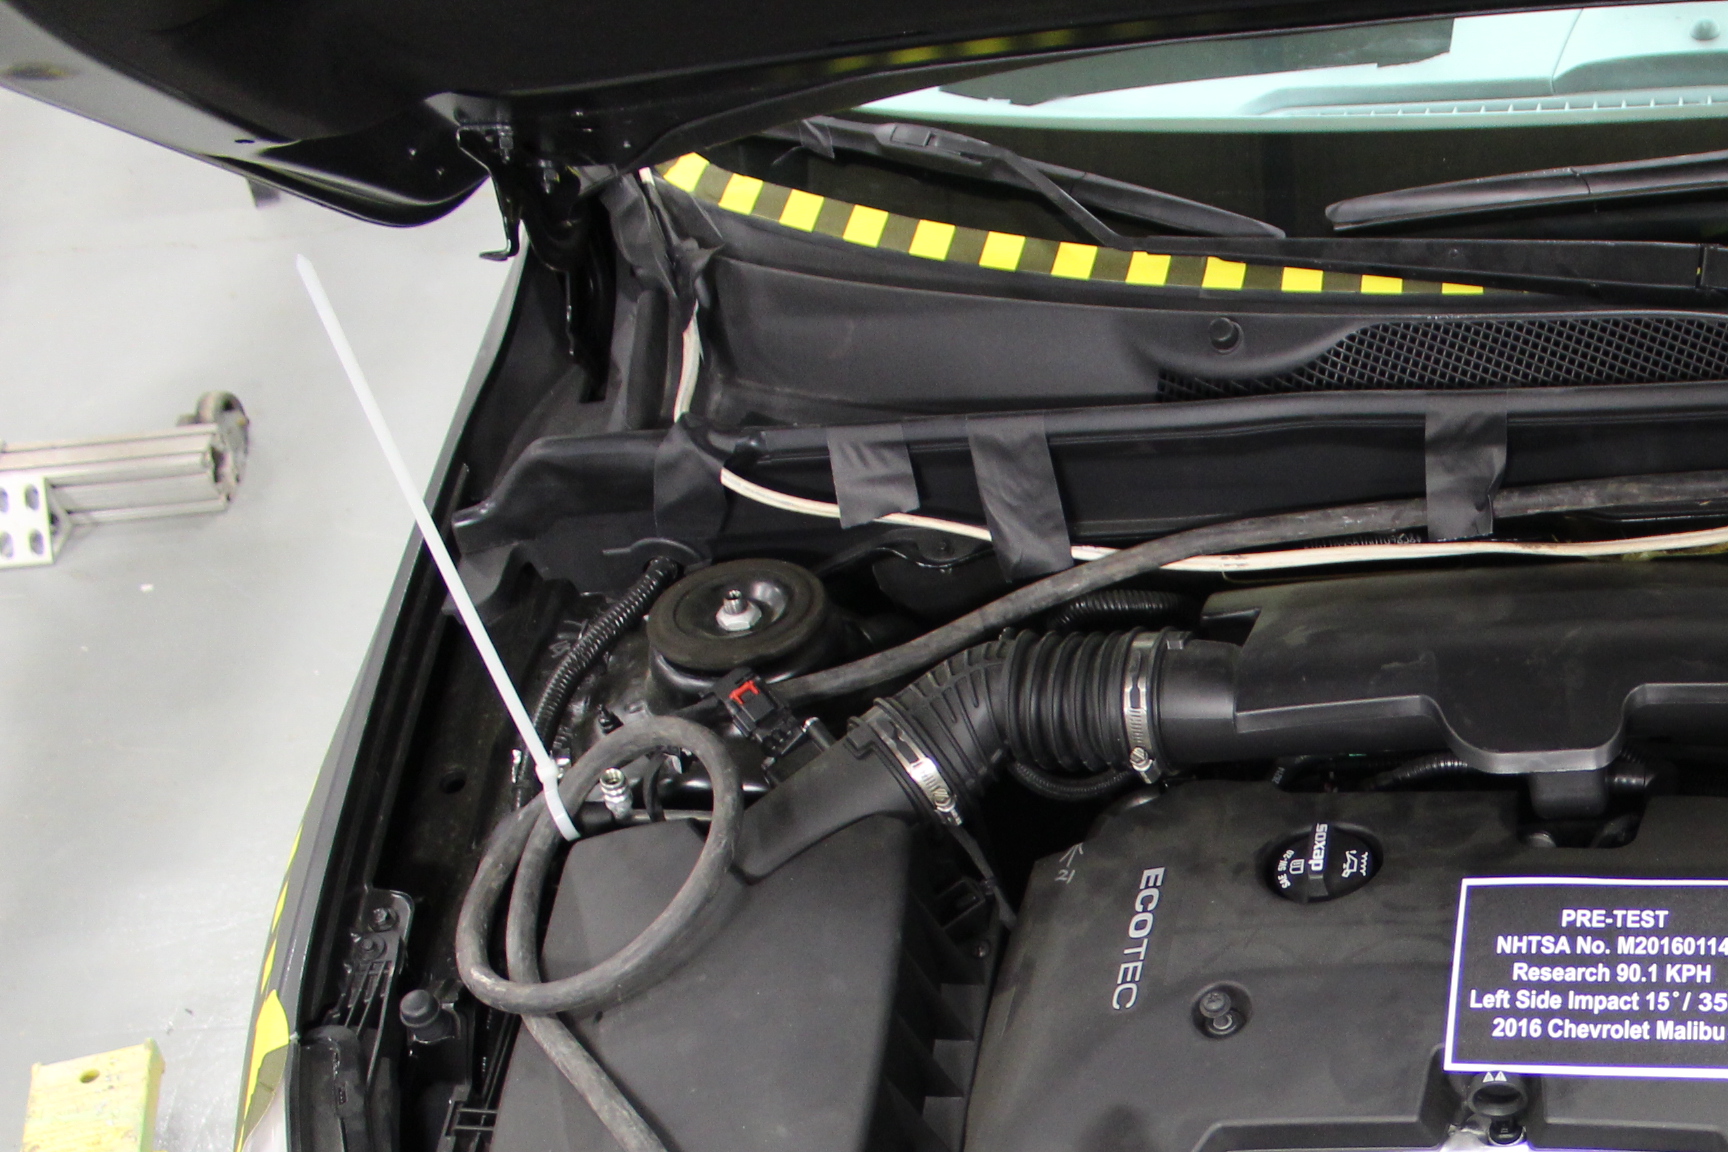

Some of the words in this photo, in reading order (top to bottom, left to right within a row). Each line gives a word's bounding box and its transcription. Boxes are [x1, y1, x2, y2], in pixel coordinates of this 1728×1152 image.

[1307, 823, 1328, 871] dexos
[1561, 909, 1669, 928] PRE-TEST
[1112, 867, 1165, 1010] ECOTEC
[1496, 936, 1570, 954] NHTSA
[1576, 936, 1610, 954] No.
[1512, 962, 1610, 982] Research
[1616, 964, 1658, 982] 90.1
[1666, 964, 1711, 982] KPH
[1469, 989, 1510, 1008] Left
[1515, 990, 1561, 1009] Side
[1569, 991, 1639, 1013] Impact
[1492, 1018, 1541, 1037] 2016
[1547, 1019, 1650, 1039] Chevrolet
[1656, 1021, 1725, 1040] Malibu
